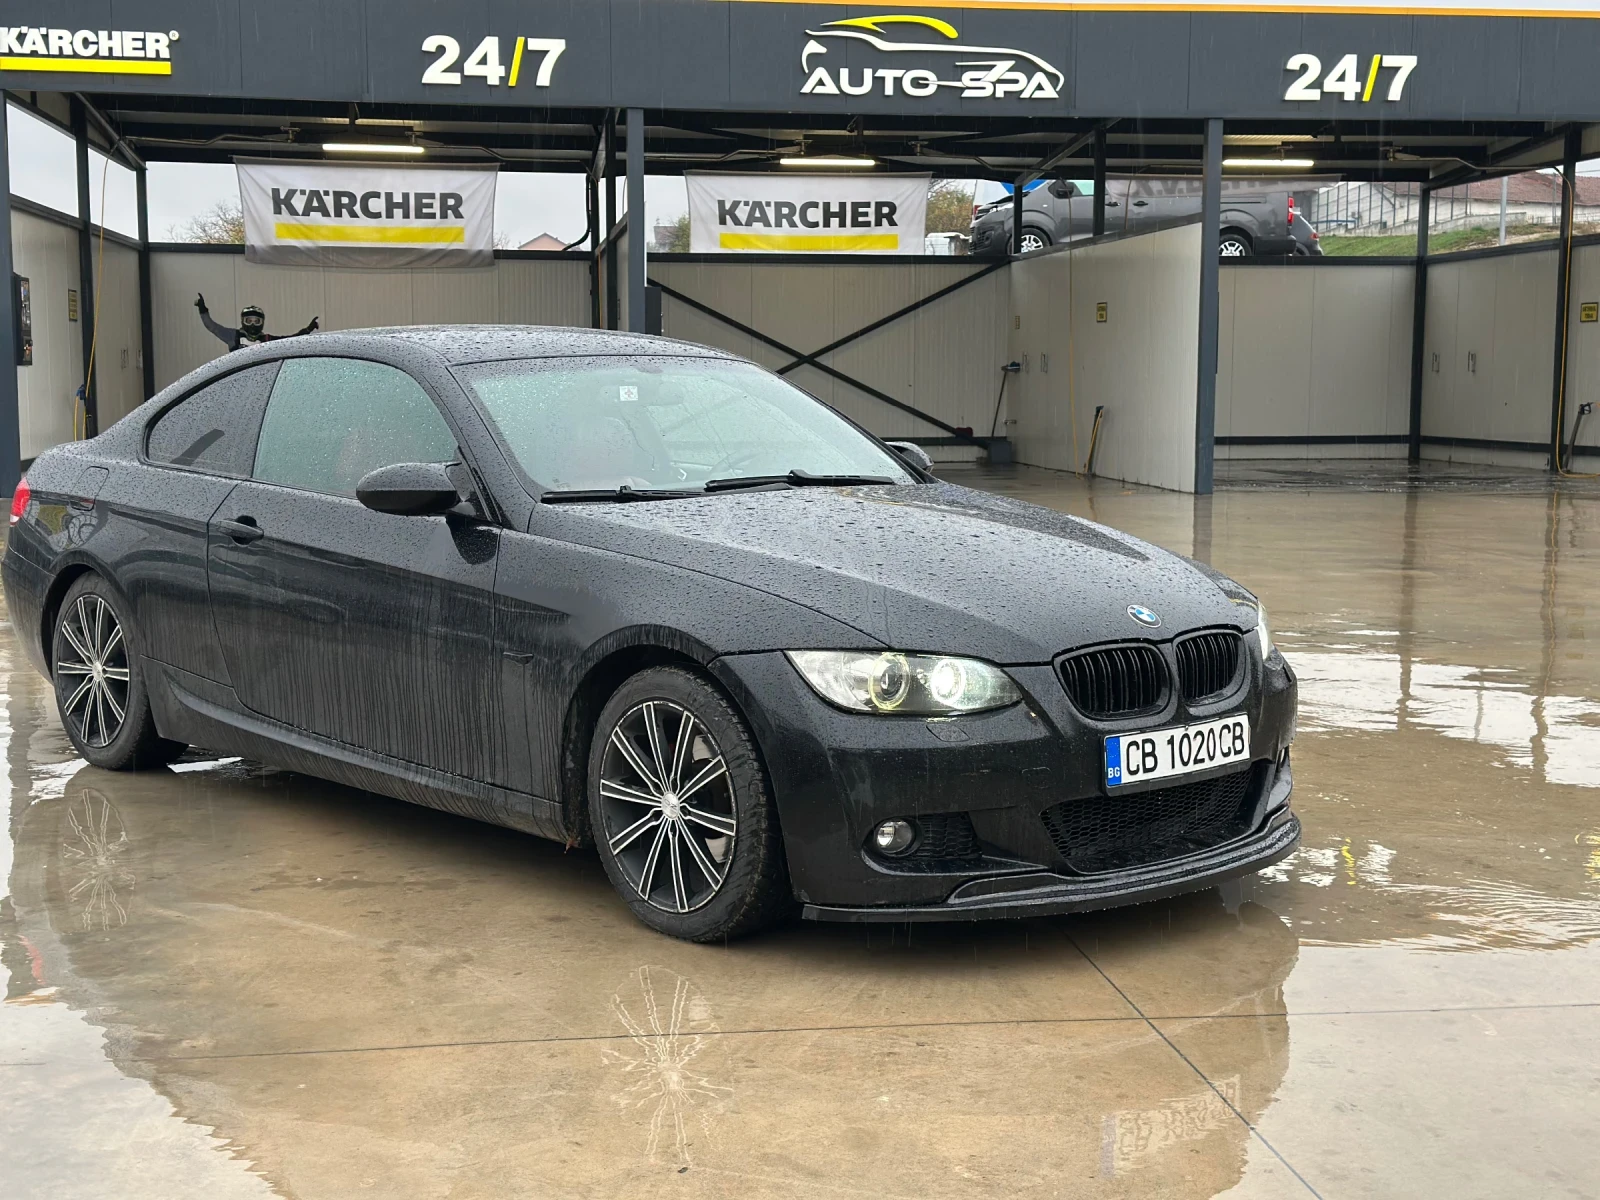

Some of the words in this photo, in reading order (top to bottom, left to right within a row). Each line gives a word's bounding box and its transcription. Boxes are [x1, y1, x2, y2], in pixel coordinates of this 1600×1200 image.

[421, 35, 566, 87] 24/7
[800, 66, 938, 96] AUTO
[958, 62, 1060, 99] SPA
[1284, 53, 1418, 102] 24/7
[271, 187, 465, 219] KÄRCHER
[717, 199, 898, 229] KÄRCHER
[1107, 766, 1121, 779] BG
[1126, 737, 1159, 776] CB
